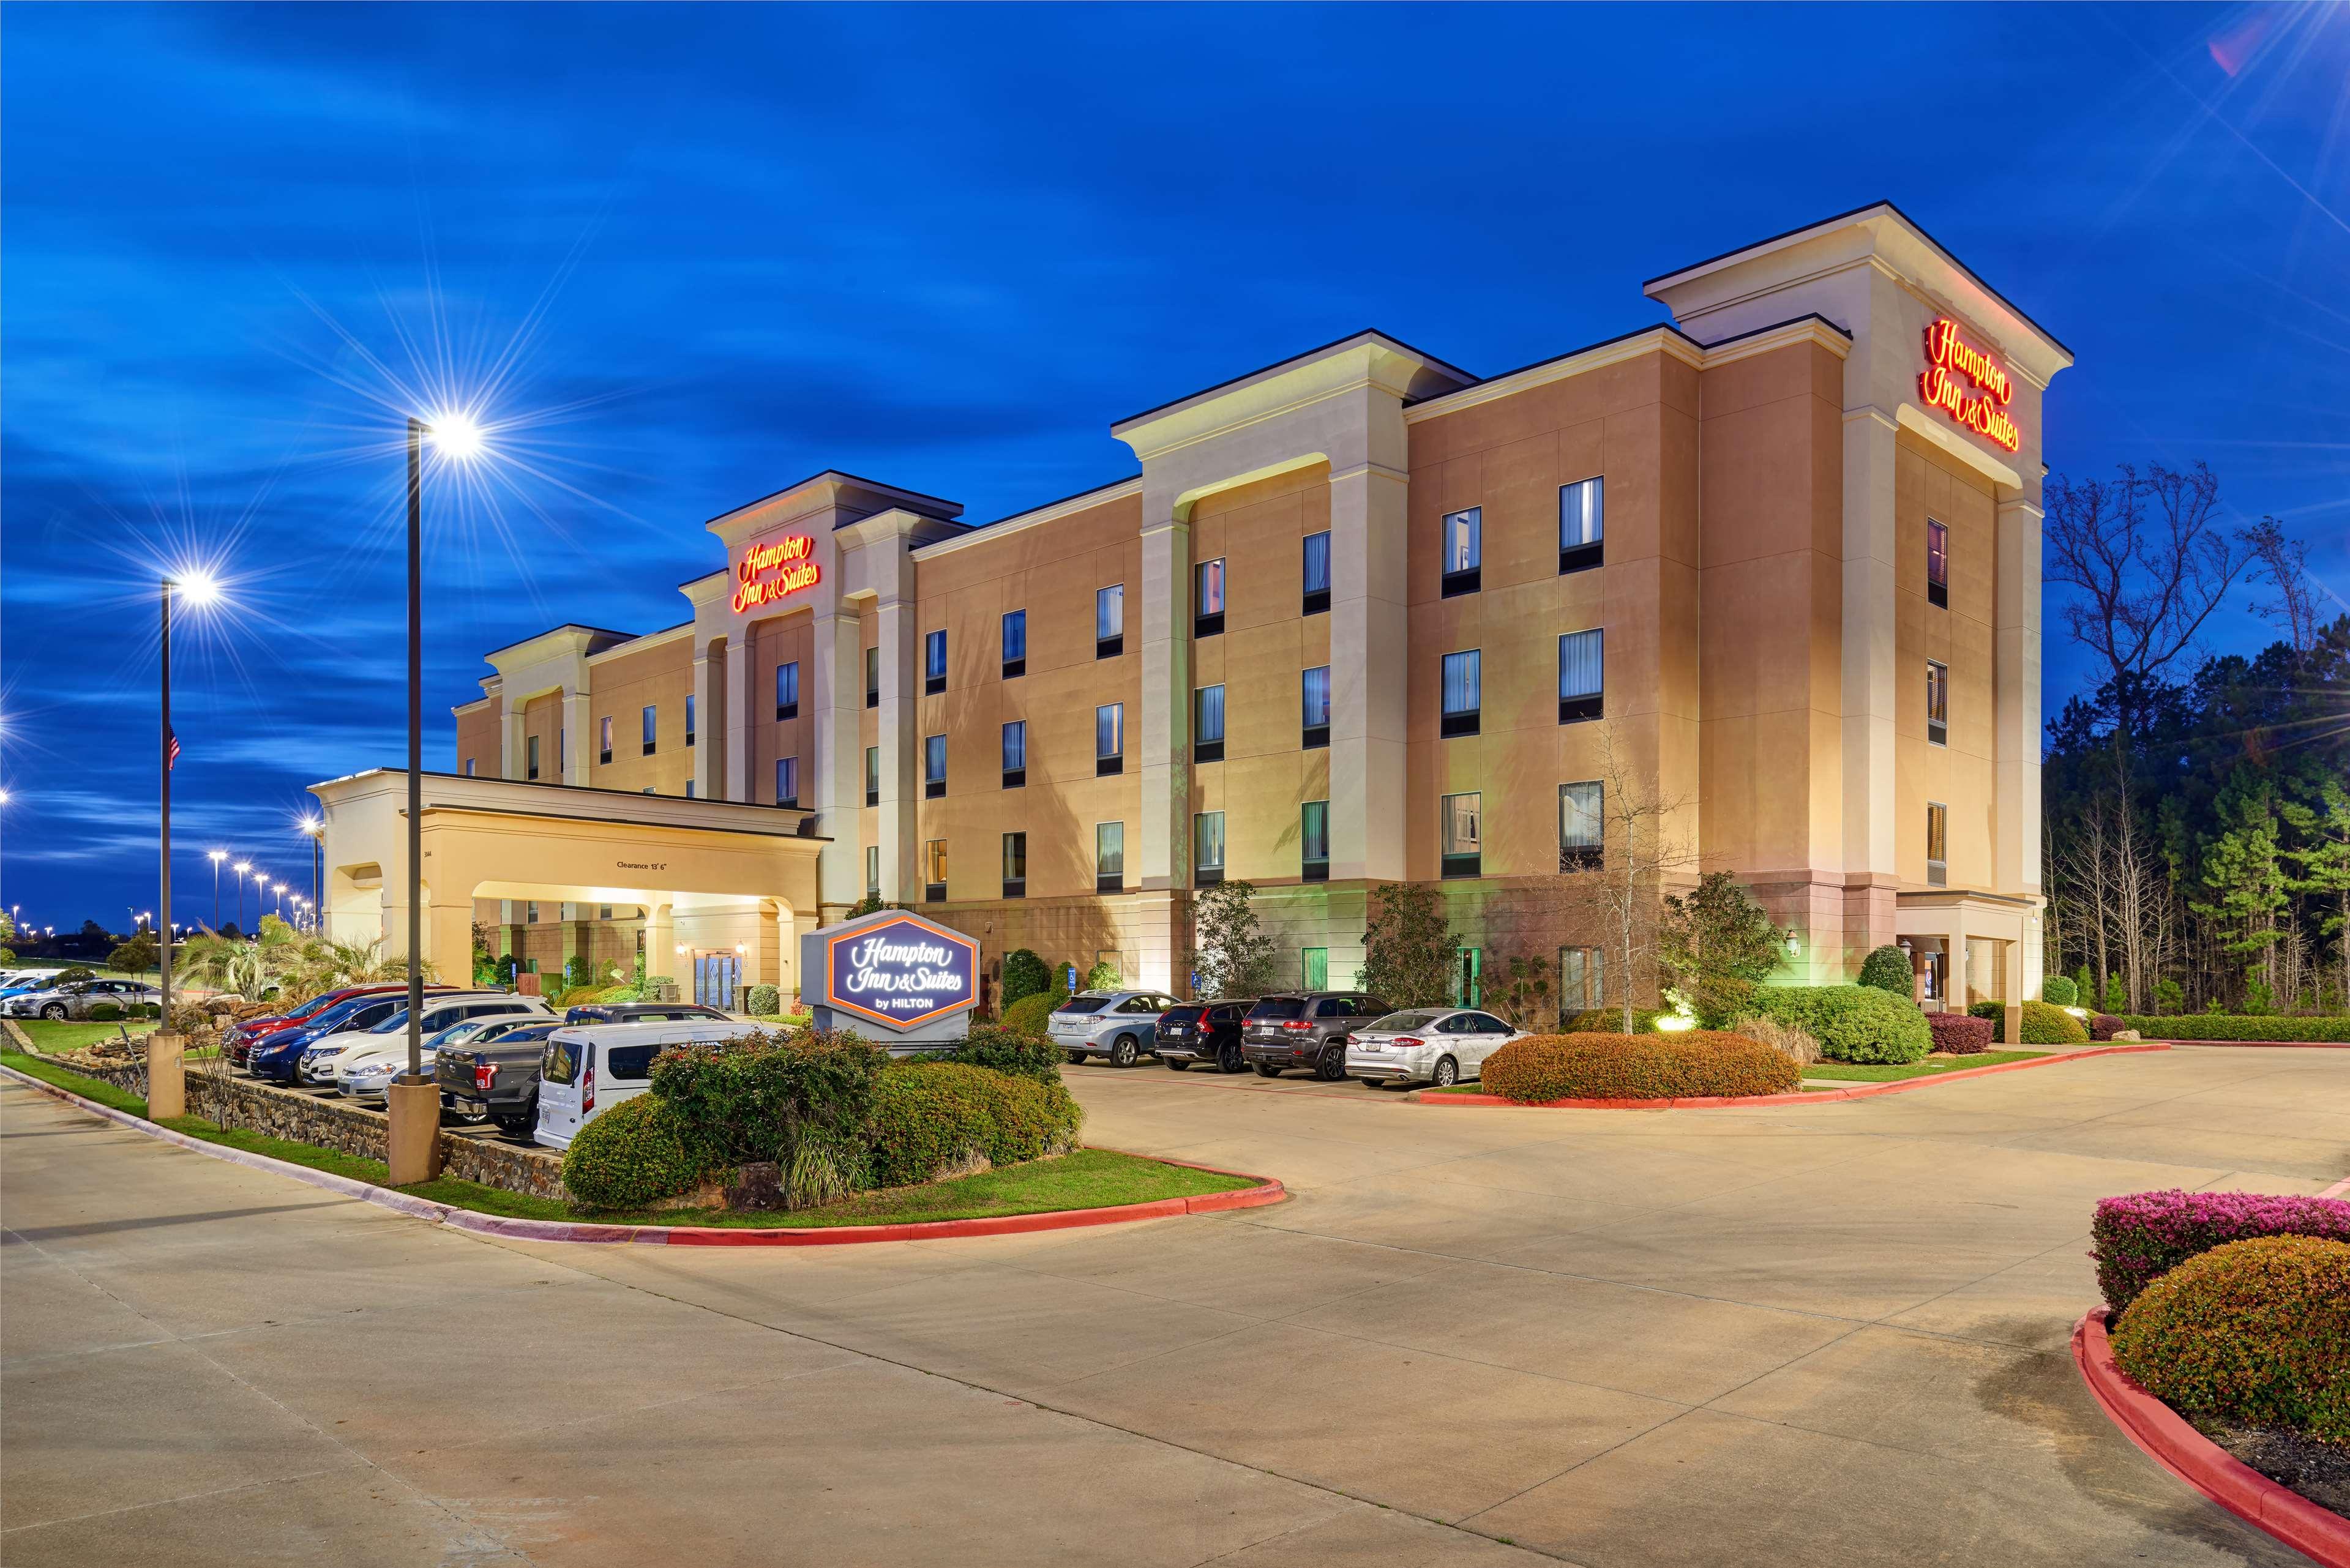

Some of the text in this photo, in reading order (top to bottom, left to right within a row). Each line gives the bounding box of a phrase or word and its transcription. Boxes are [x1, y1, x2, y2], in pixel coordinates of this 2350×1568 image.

[1928, 320, 2011, 405] Hampton
[1922, 367, 2019, 452] Inn & Suites
[738, 536, 814, 583] Hampton
[733, 563, 820, 613] Inn & Suites
[851, 936, 952, 968] Hampton
[847, 967, 962, 993] Inn & Suites
[875, 998, 933, 1010] by HILTON
